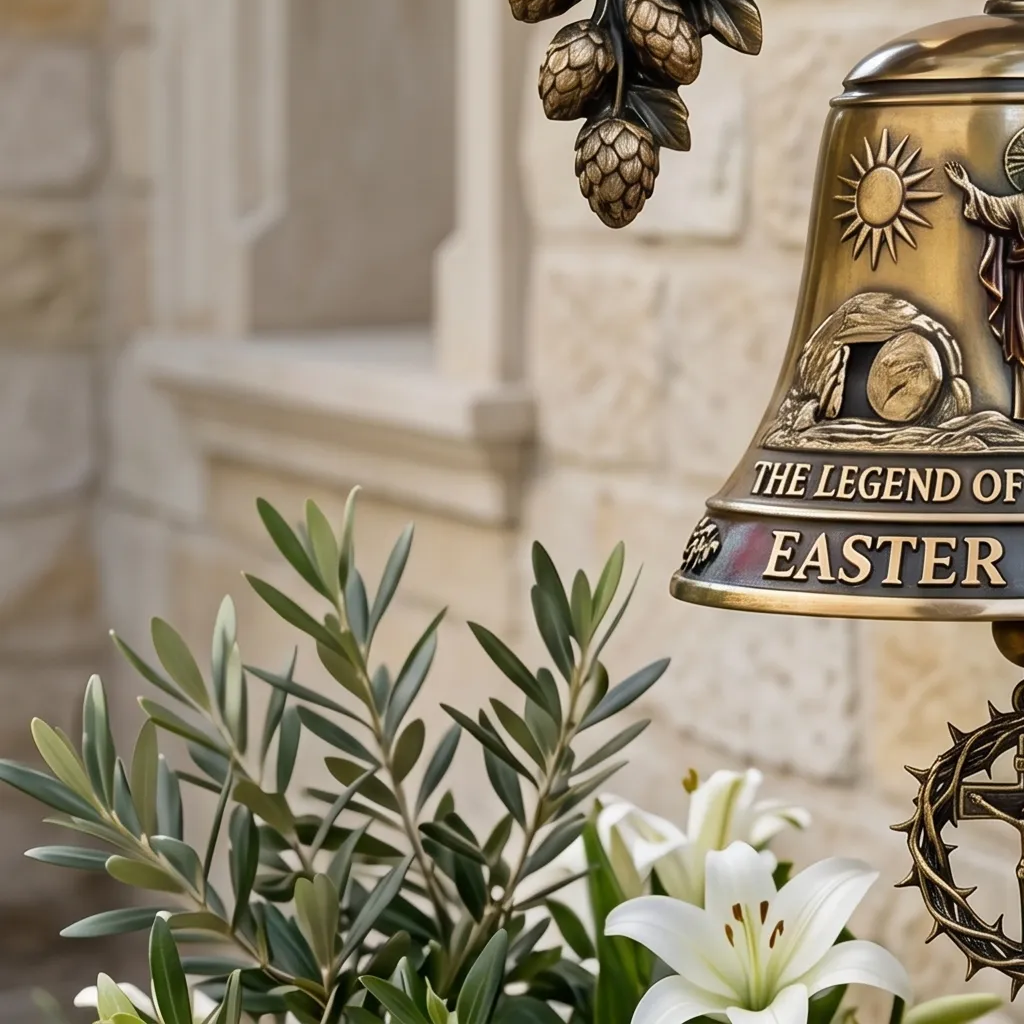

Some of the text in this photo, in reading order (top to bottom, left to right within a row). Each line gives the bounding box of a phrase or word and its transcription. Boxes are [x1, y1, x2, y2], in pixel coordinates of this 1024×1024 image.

[751, 460, 812, 496] THE
[813, 464, 961, 502] LEGEND
[972, 468, 1024, 503] OF
[762, 529, 1007, 586] EASTER
